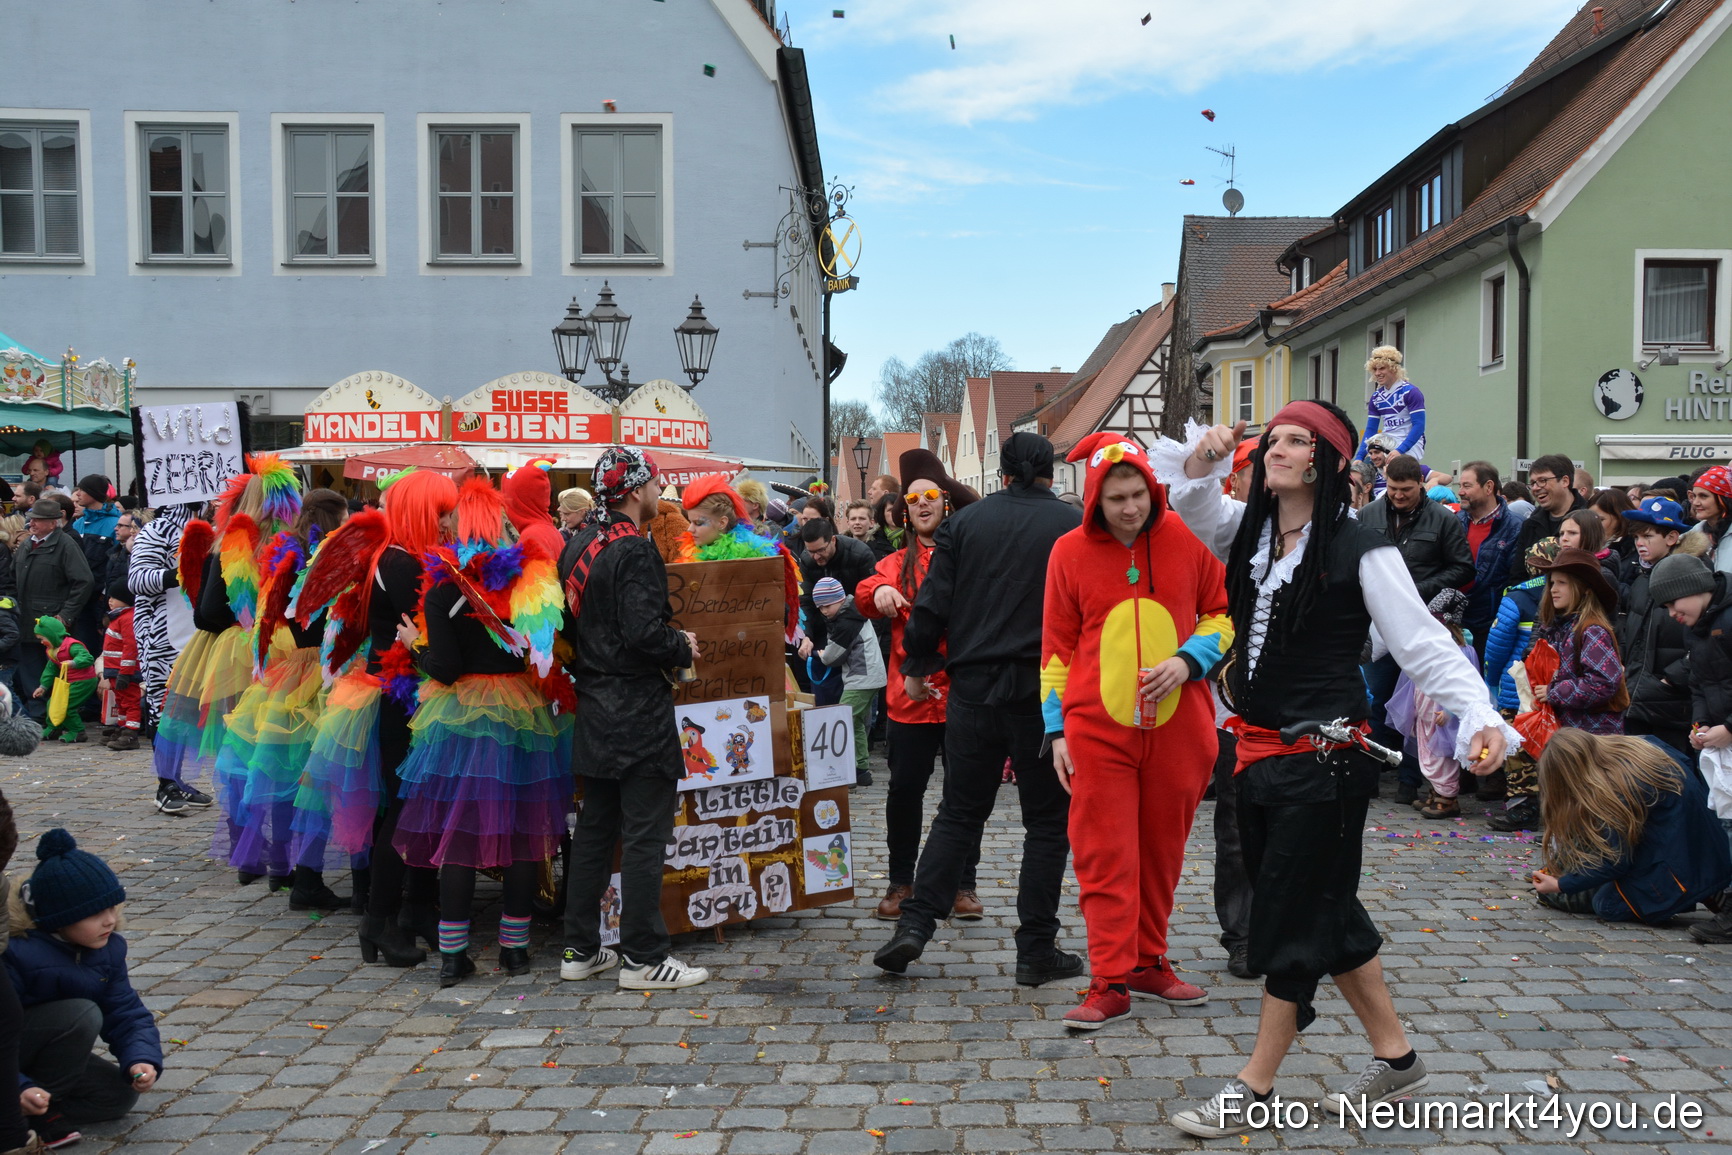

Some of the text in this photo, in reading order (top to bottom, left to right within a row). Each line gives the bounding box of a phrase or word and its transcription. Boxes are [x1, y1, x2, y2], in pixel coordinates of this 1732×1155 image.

[828, 278, 850, 291] BANK
[1665, 397, 1732, 420] HINT
[308, 414, 439, 439] MANDELN
[486, 414, 590, 440] BIENE
[620, 418, 707, 446] POPCORN
[1669, 447, 1715, 459] FLUG
[811, 720, 847, 759] 40
[711, 862, 744, 887] in
[691, 891, 753, 921] you
